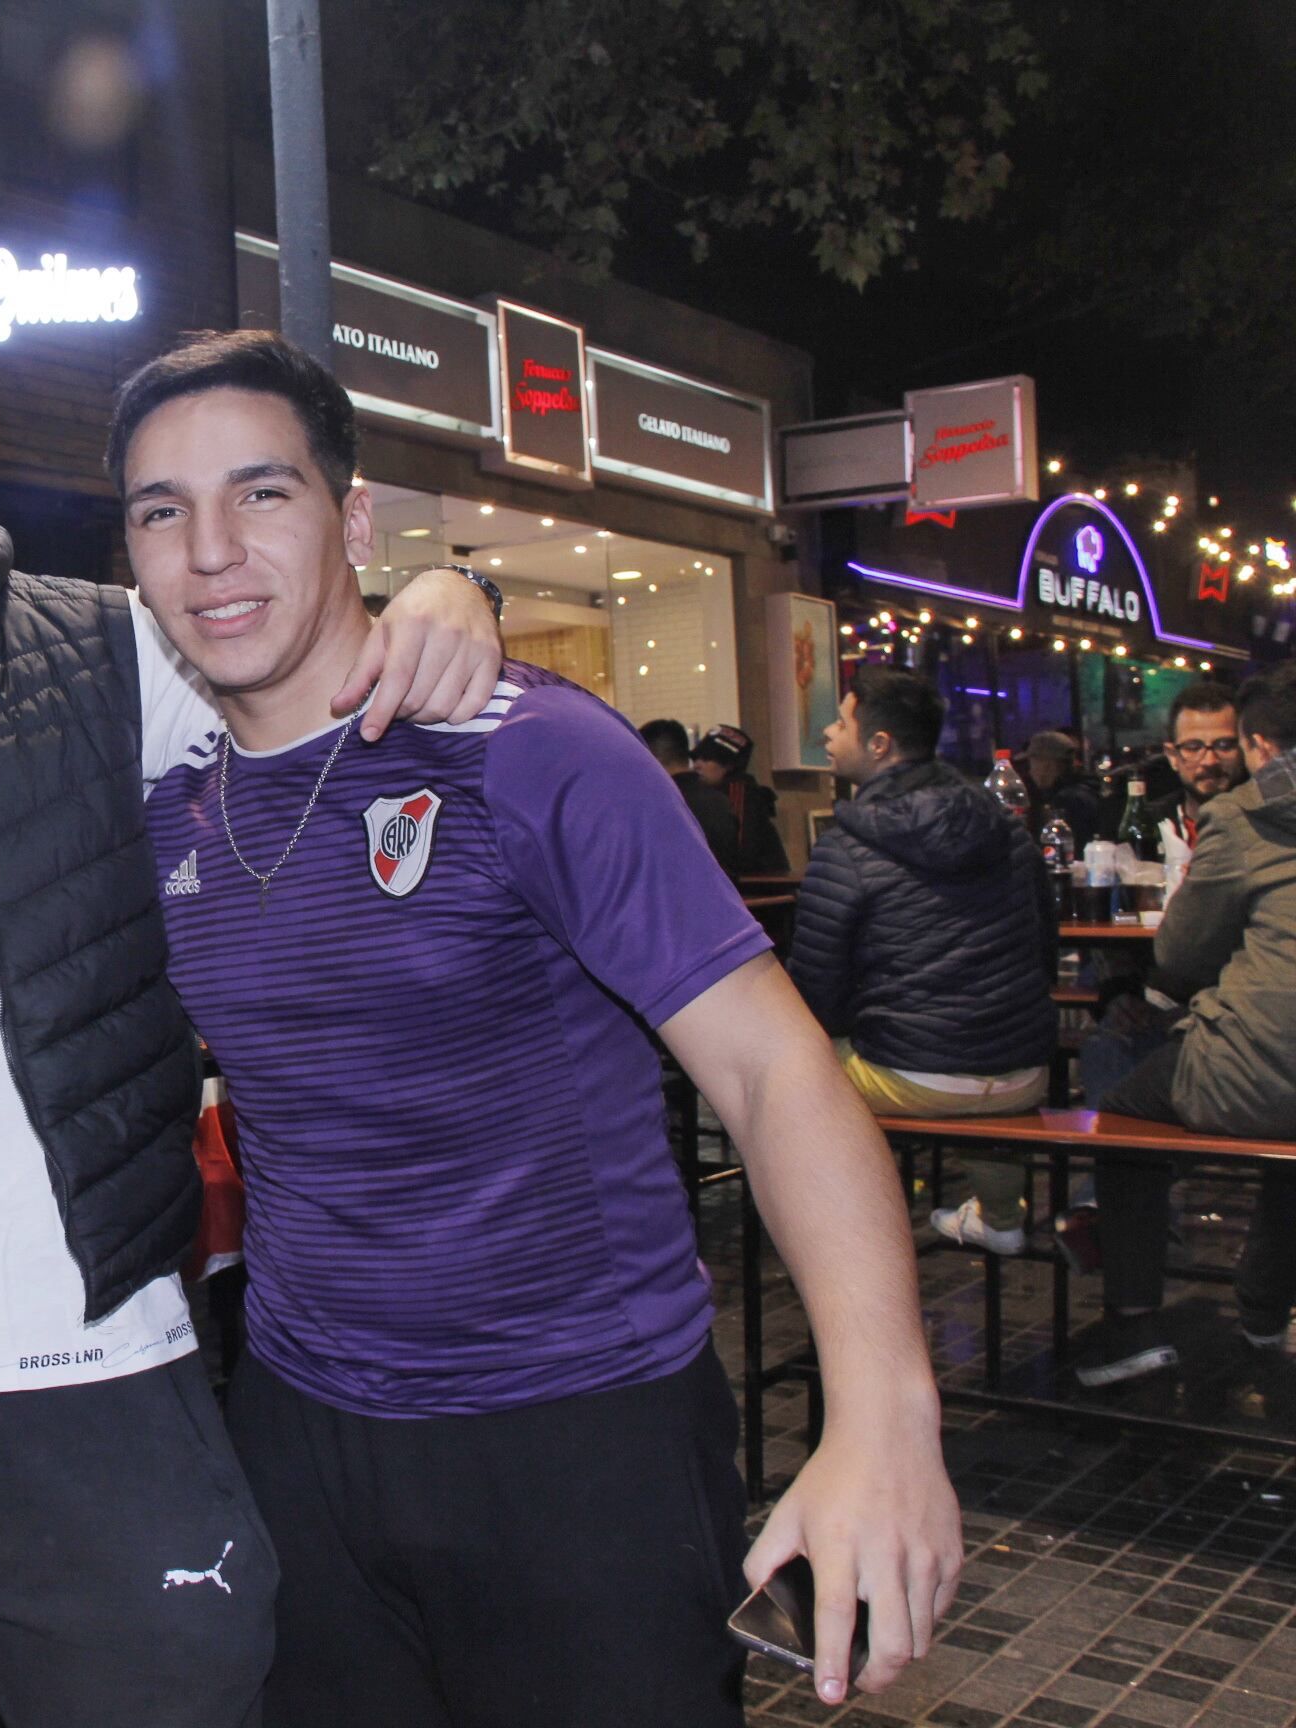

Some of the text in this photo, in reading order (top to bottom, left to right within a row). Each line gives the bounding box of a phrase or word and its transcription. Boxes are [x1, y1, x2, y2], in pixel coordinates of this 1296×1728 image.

[332, 323, 440, 369] ATO ITALIANO
[638, 412, 731, 454] GELATO ITALIANO
[1038, 567, 1141, 622] BUFFALO
